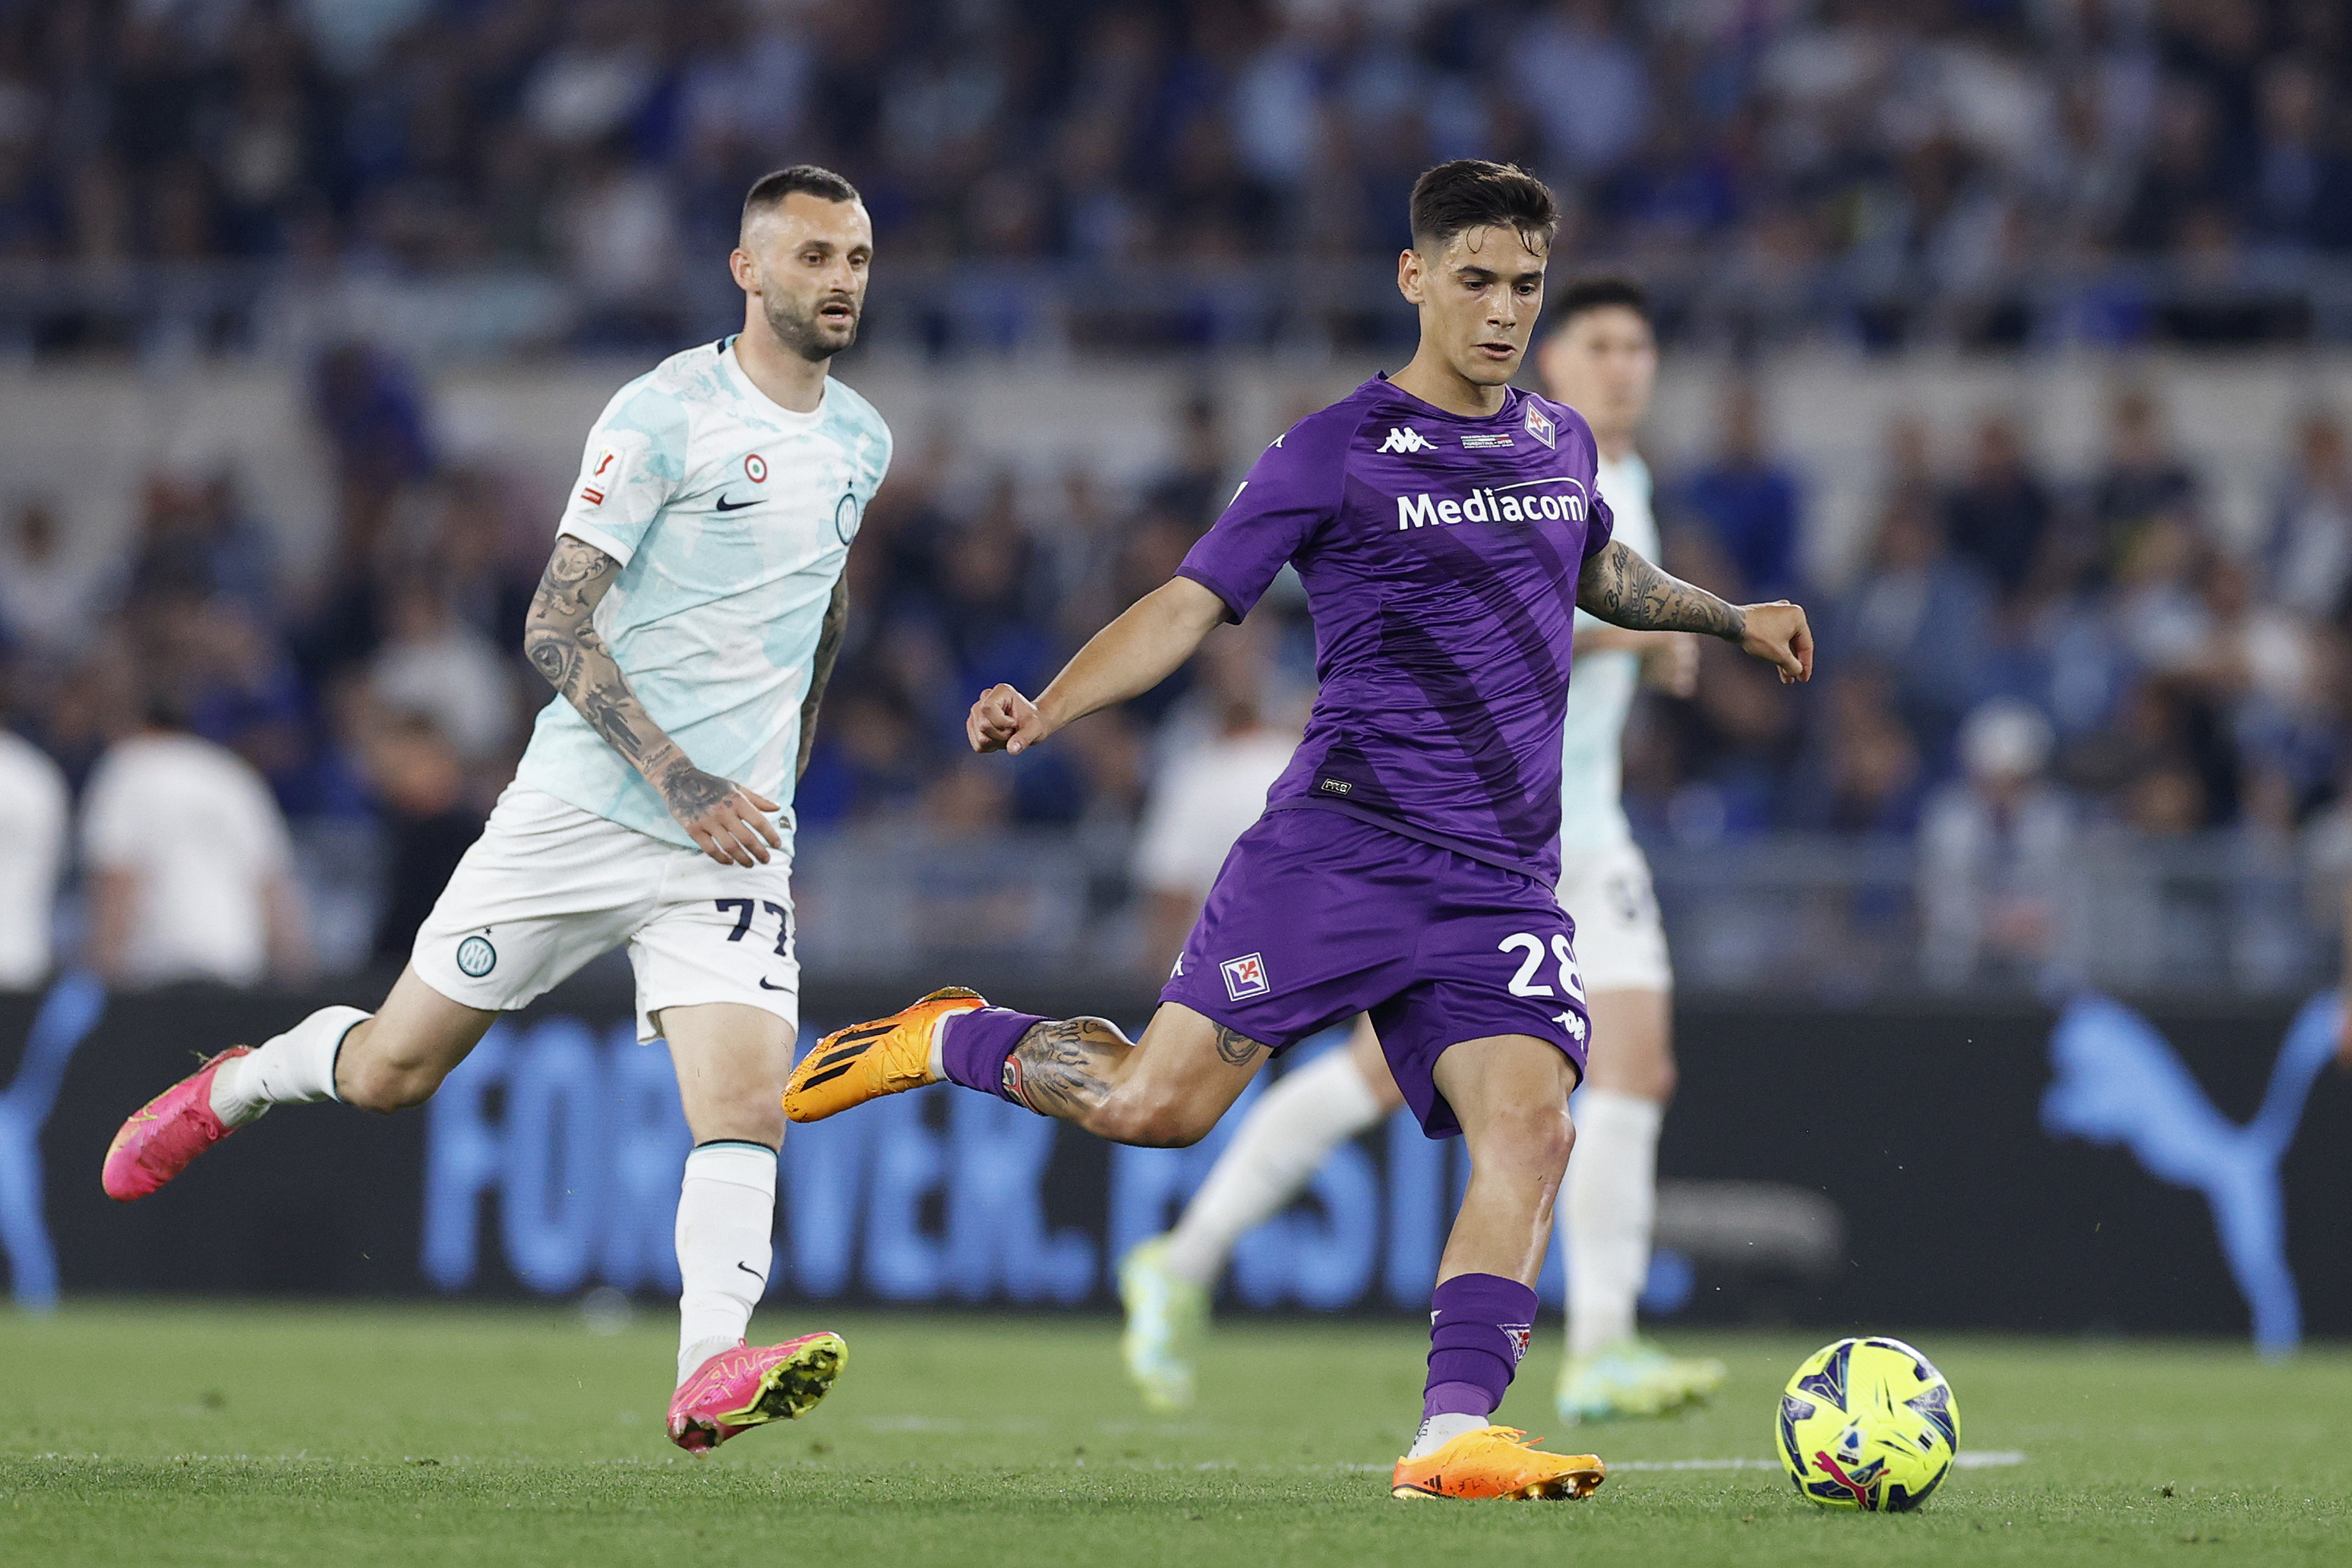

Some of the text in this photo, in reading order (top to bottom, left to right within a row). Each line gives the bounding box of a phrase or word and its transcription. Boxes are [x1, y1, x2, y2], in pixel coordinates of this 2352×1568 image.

[1397, 487, 1585, 531] Mediacom
[715, 898, 787, 957] 77
[1498, 932, 1586, 1005] 28
